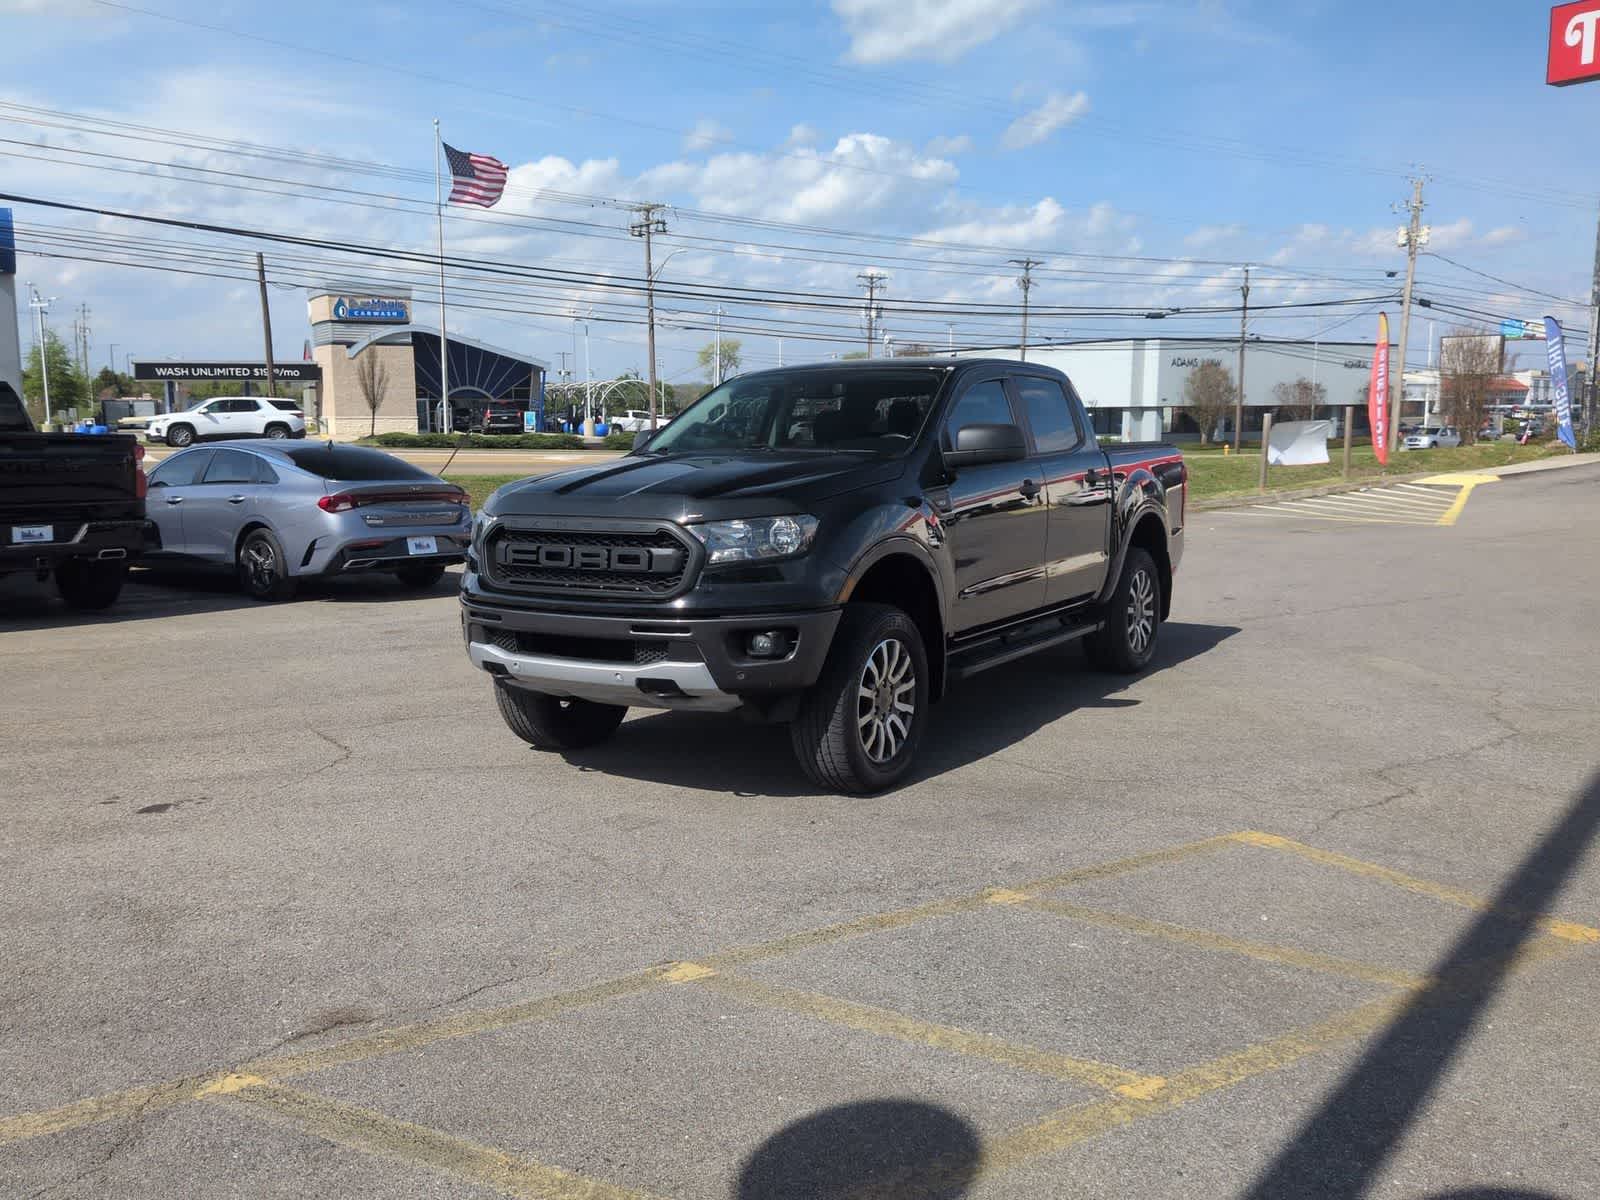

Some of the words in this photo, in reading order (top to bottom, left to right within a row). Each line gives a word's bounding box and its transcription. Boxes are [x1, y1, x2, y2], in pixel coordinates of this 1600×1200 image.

[1171, 357, 1198, 368] ADAMS
[154, 367, 189, 376] WASH
[191, 367, 250, 376] UNLIMITED
[506, 541, 650, 571] FORD
